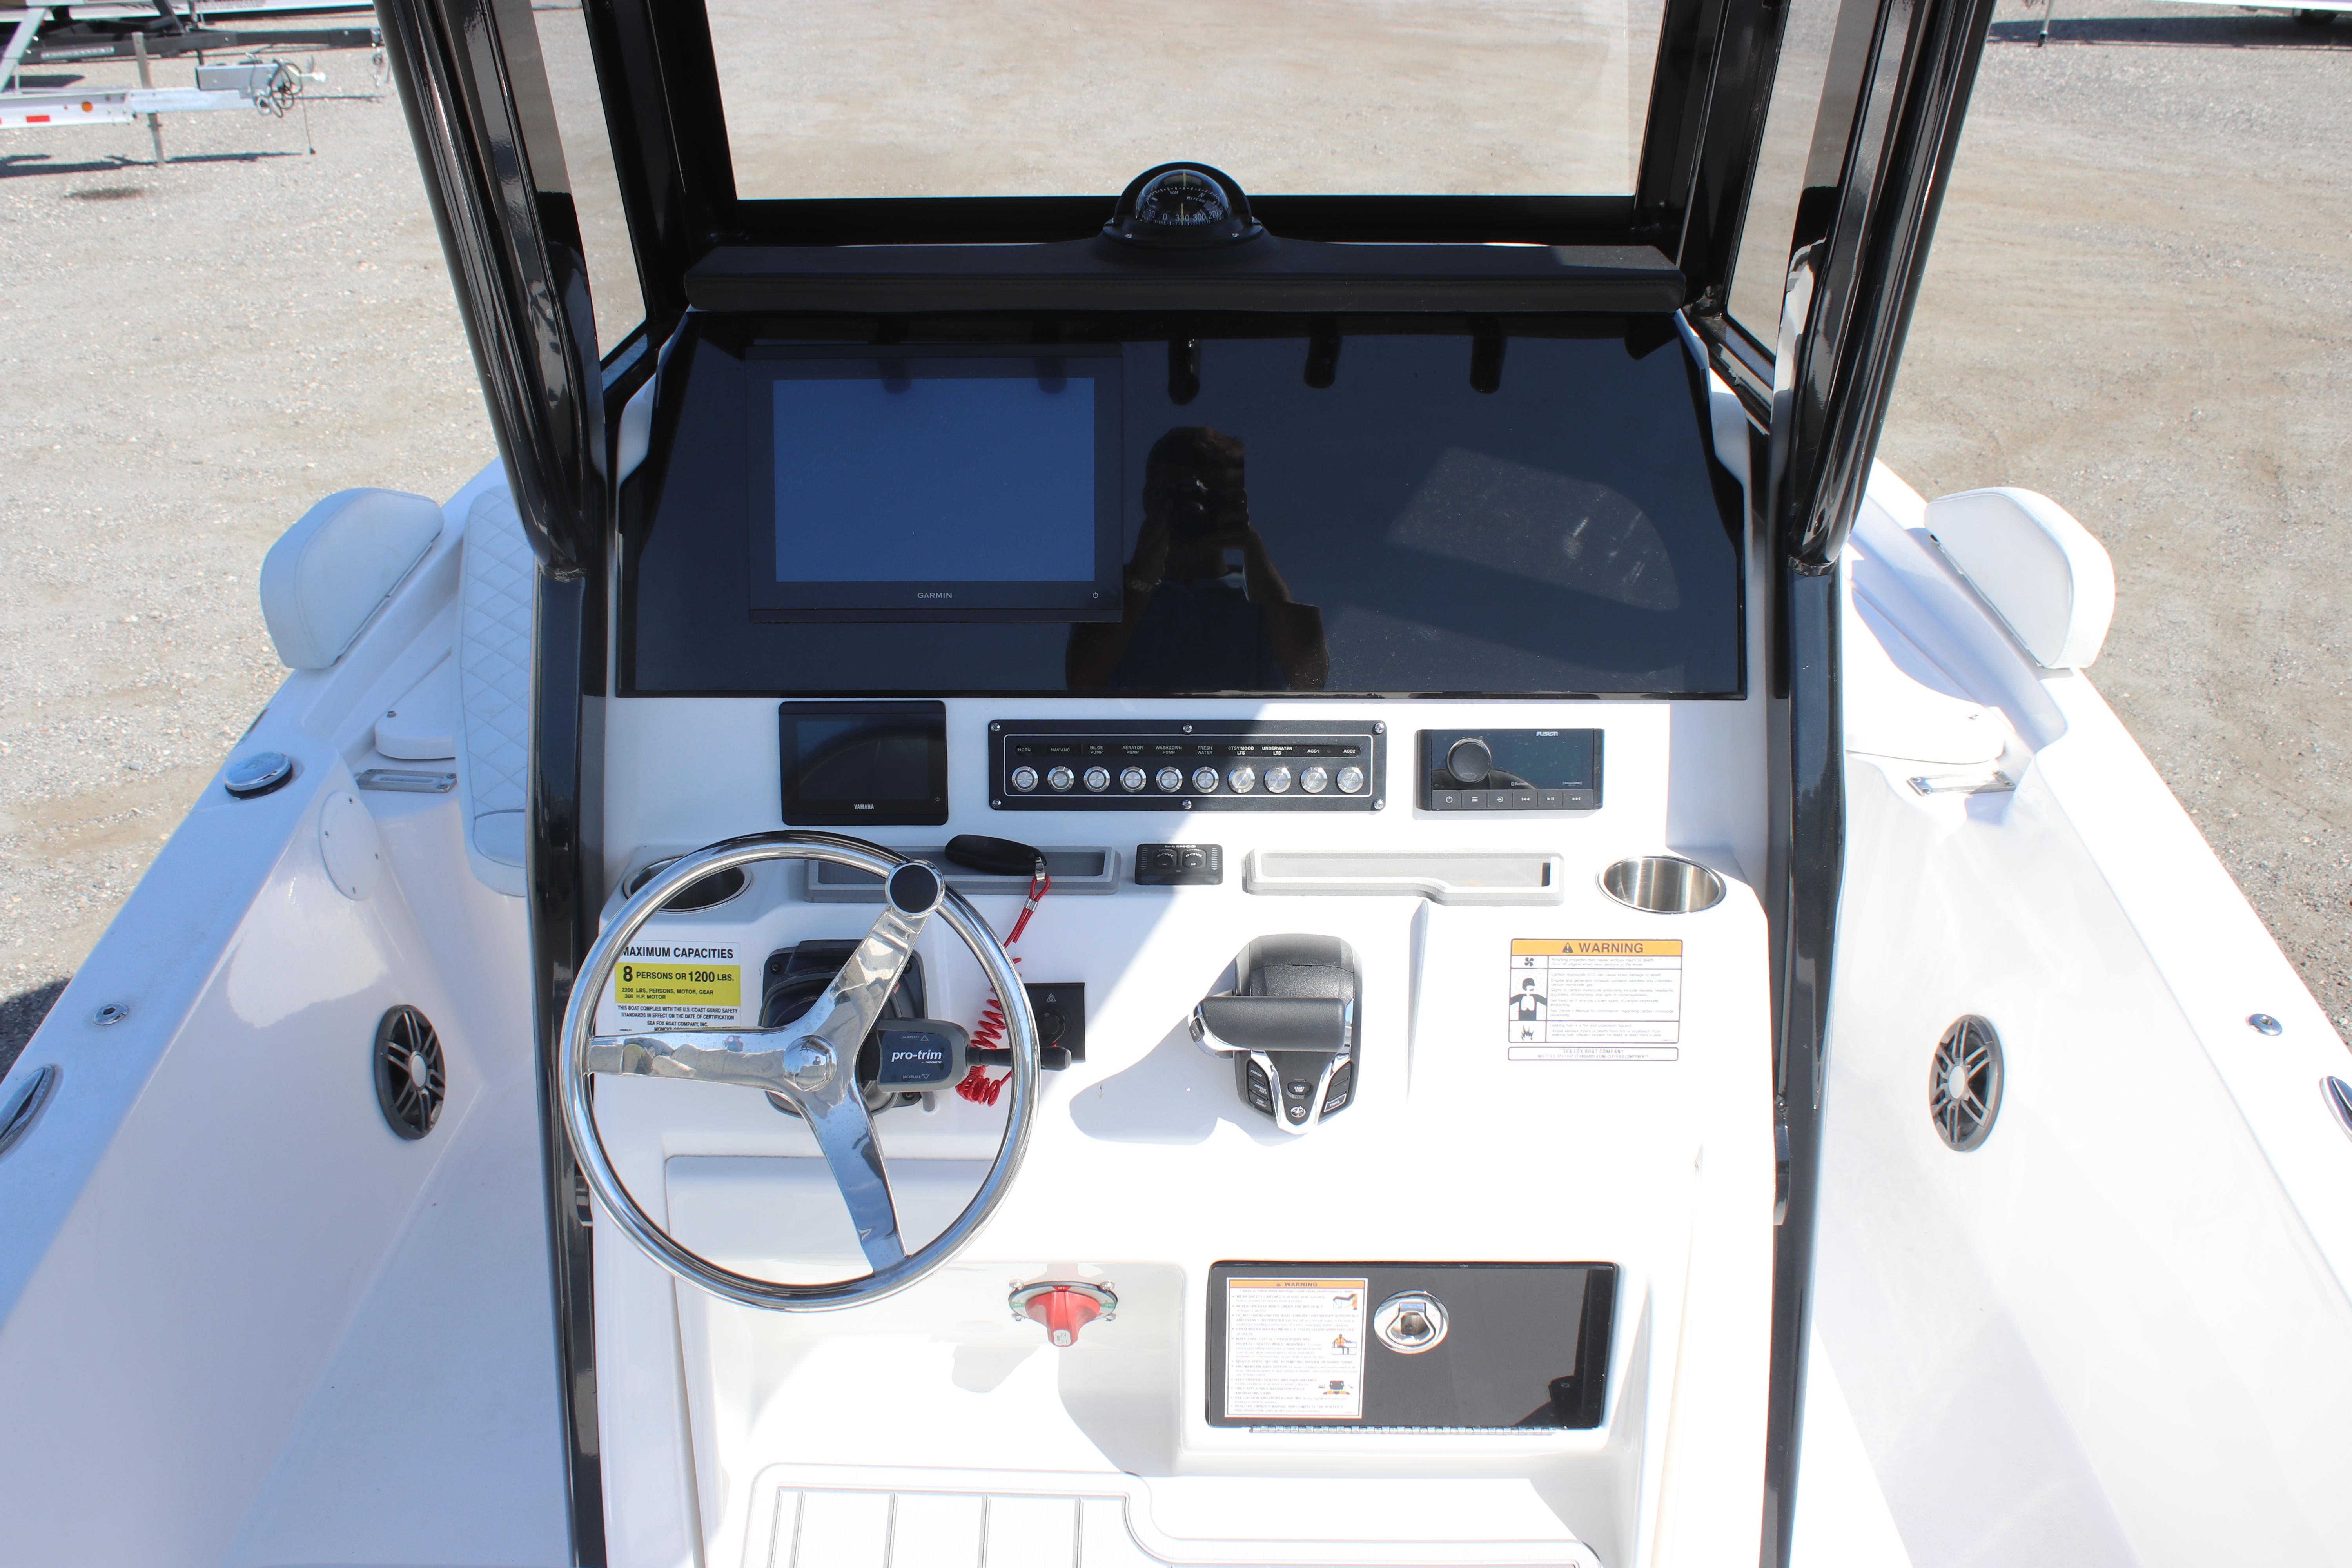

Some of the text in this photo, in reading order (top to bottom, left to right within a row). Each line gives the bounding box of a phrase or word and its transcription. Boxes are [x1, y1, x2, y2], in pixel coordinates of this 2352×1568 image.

[1149, 210, 1155, 218] 30
[1209, 210, 1218, 219] 270
[621, 946, 733, 959] MAXIMUM CAPACITIES
[1579, 942, 1644, 953] WARNING
[623, 966, 633, 982] 8
[636, 971, 673, 980] PERSONS
[688, 971, 715, 982] 1200
[891, 1049, 942, 1062] pro-trim
